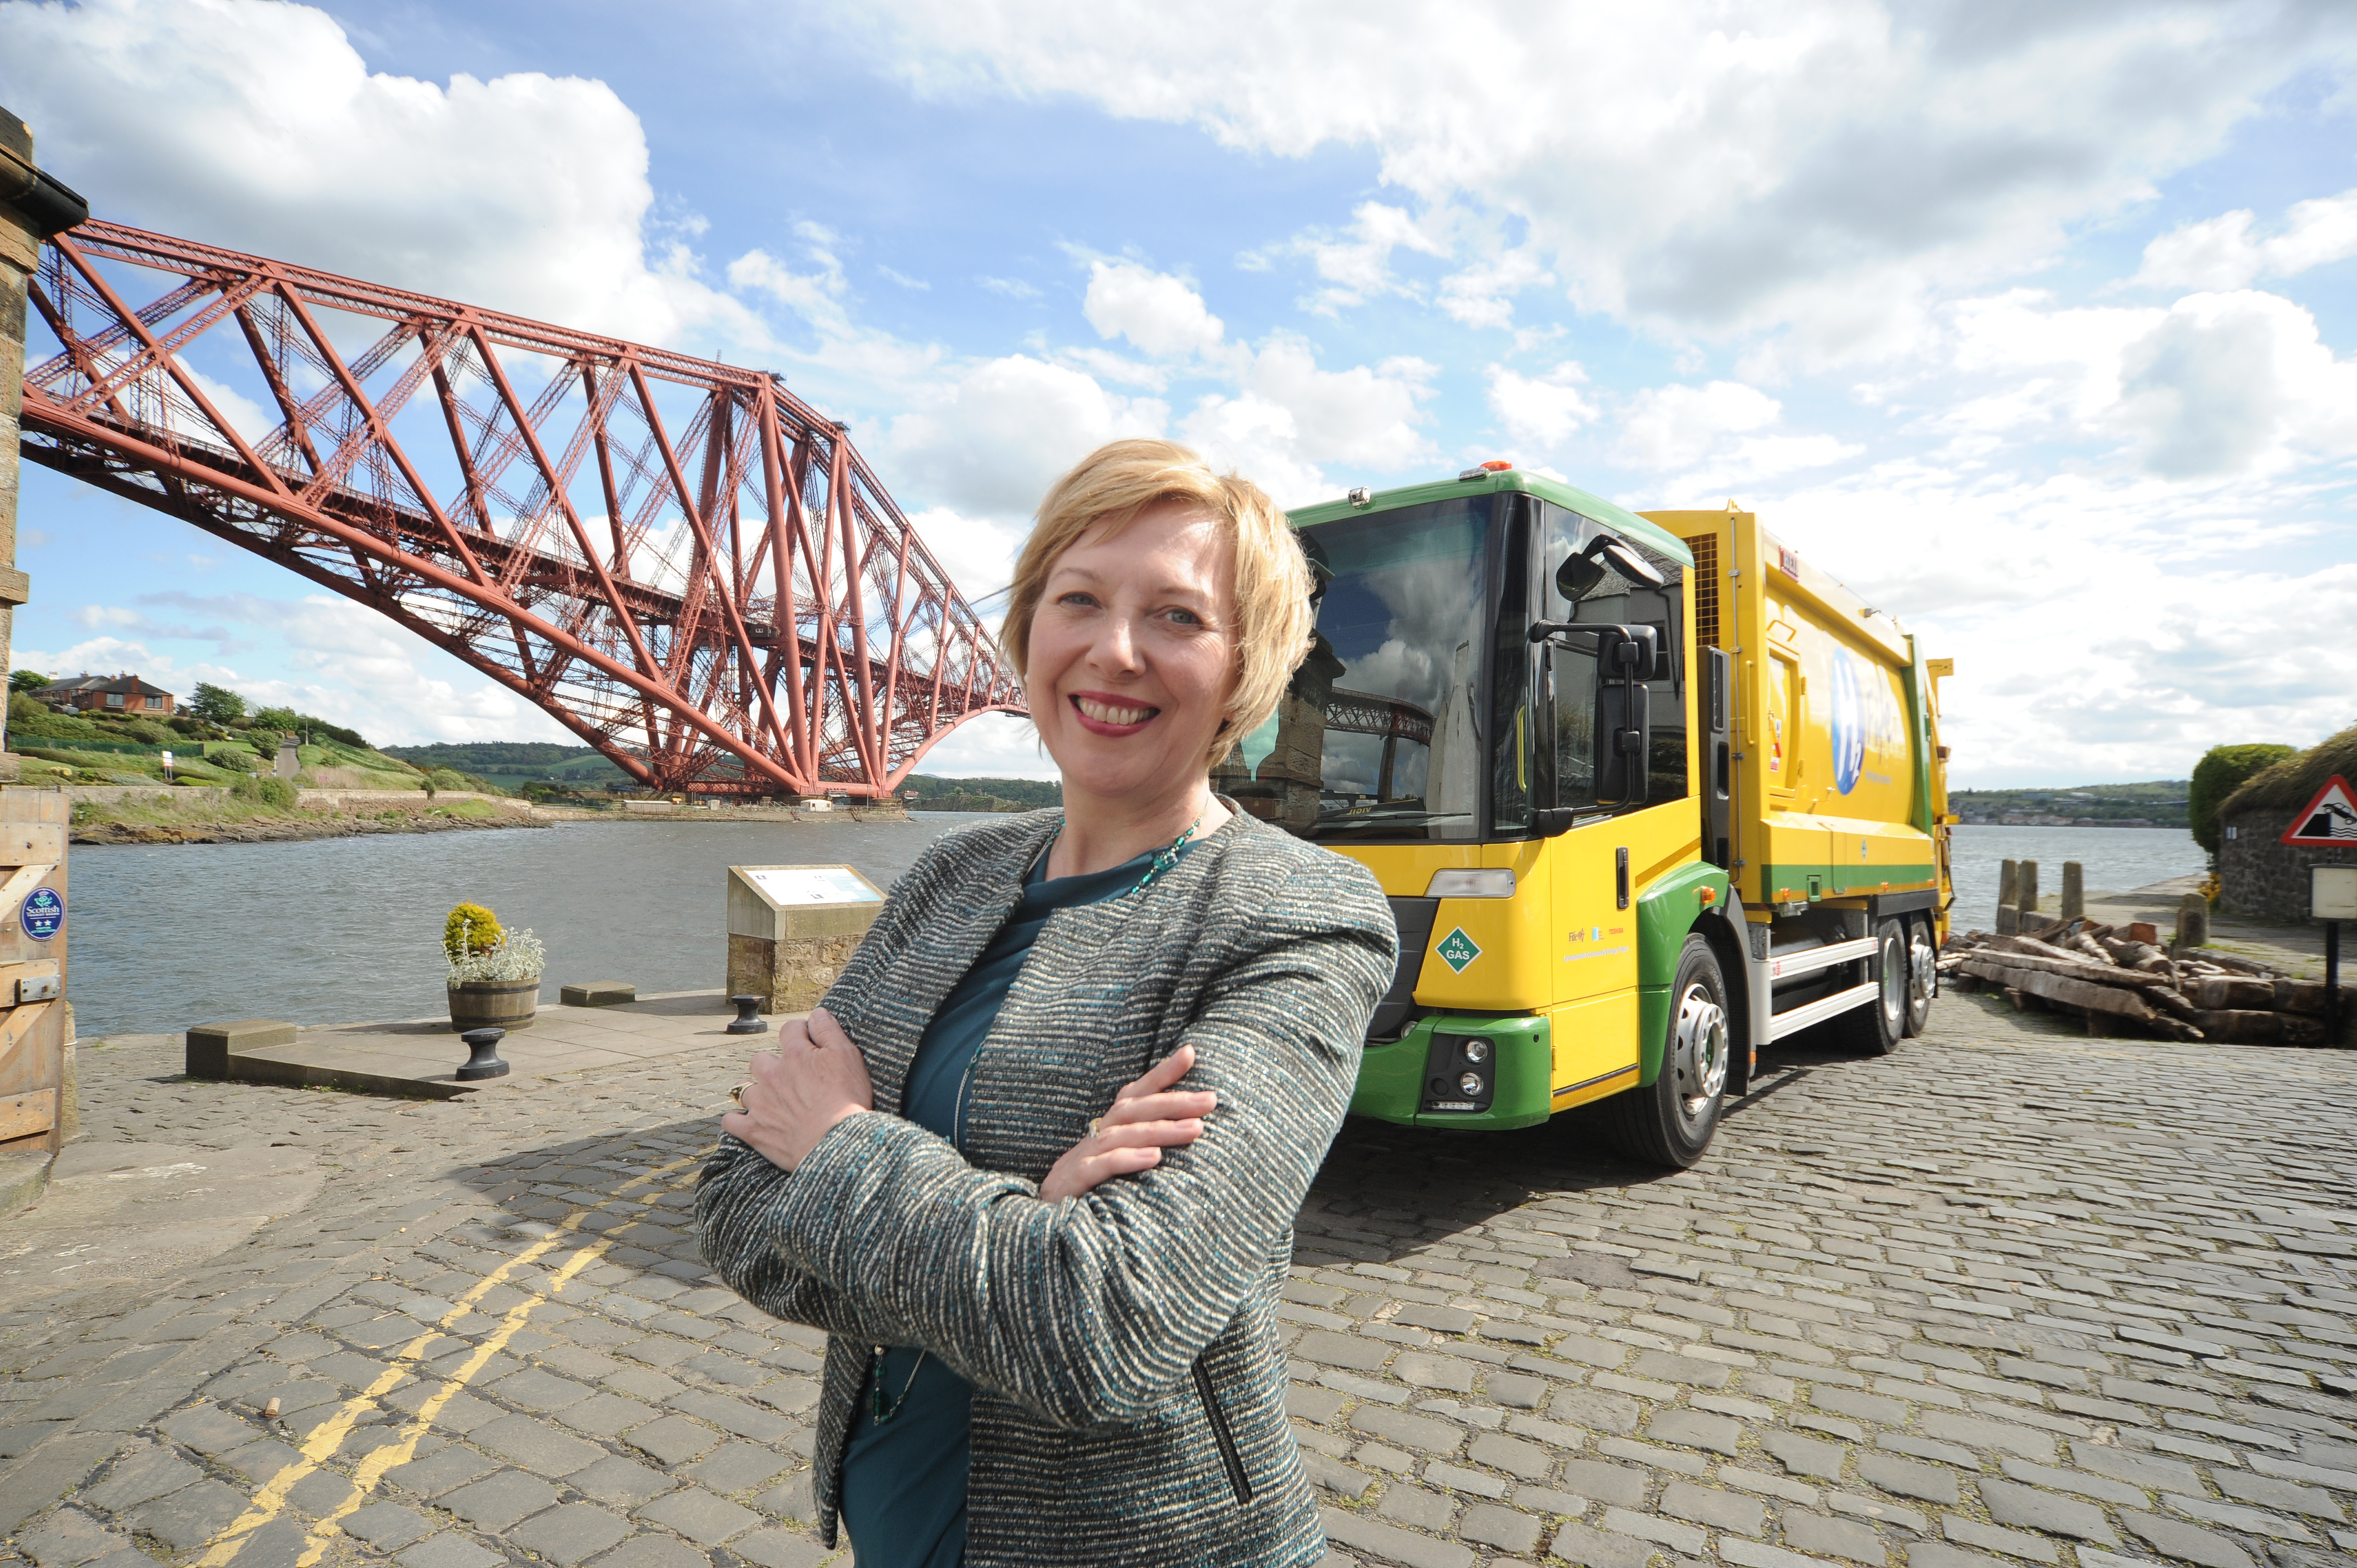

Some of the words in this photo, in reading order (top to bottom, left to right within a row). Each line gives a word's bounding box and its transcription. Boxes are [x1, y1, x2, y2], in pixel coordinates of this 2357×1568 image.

[26, 905, 60, 914] Scottish
[1452, 938, 1464, 949] H2
[1446, 950, 1470, 960] GAS
